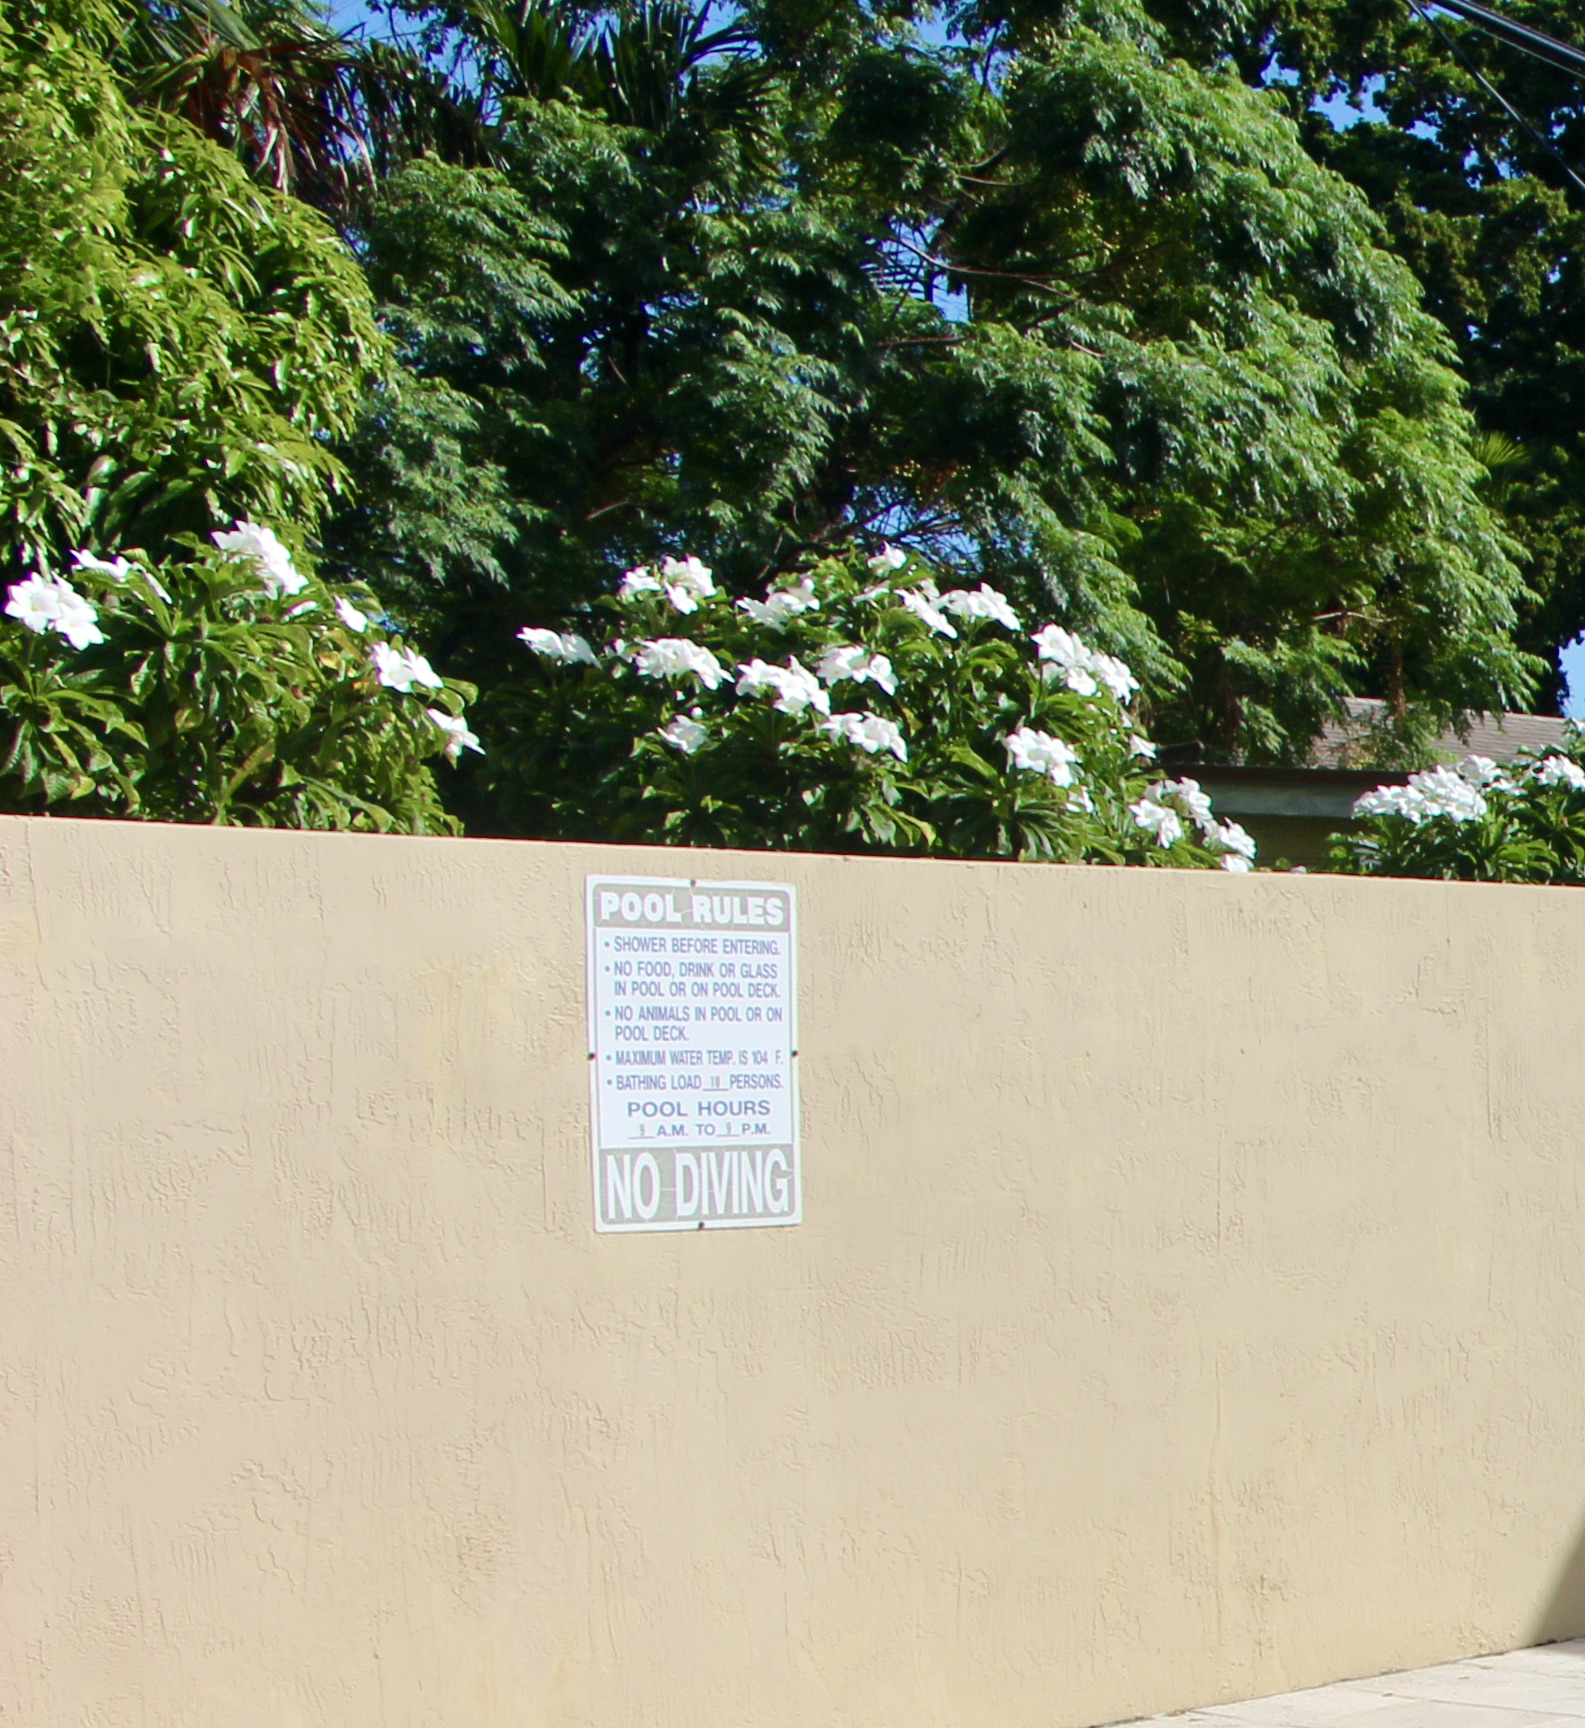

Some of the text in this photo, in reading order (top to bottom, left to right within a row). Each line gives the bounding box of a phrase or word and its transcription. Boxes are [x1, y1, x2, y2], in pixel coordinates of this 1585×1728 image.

[600, 891, 784, 926] POOL RULES
[614, 936, 781, 956] SHOWER BEFORE ENTERING.
[614, 961, 778, 979] NO FOOD, DRINK OR GLASS
[614, 981, 781, 999] IN POOL OR ON POOL DECK.
[614, 1005, 783, 1022] NO ANIMALS IN POOL OR ON
[615, 1025, 689, 1041] POOL DECK.
[615, 1050, 666, 1065] MAXIMUM
[670, 1050, 703, 1065] WATER
[707, 1050, 736, 1065] TEMP.
[739, 1050, 748, 1065] IS
[752, 1051, 768, 1064] 104
[616, 1074, 667, 1091] BATHING
[671, 1074, 701, 1090] LOAD
[729, 1074, 784, 1090] PERSONS.
[627, 1100, 771, 1118] POOL HOURS
[657, 1124, 688, 1137] A.M.
[695, 1124, 716, 1136] TO
[741, 1123, 771, 1136] P.M.
[606, 1149, 793, 1220] NO DIVING
